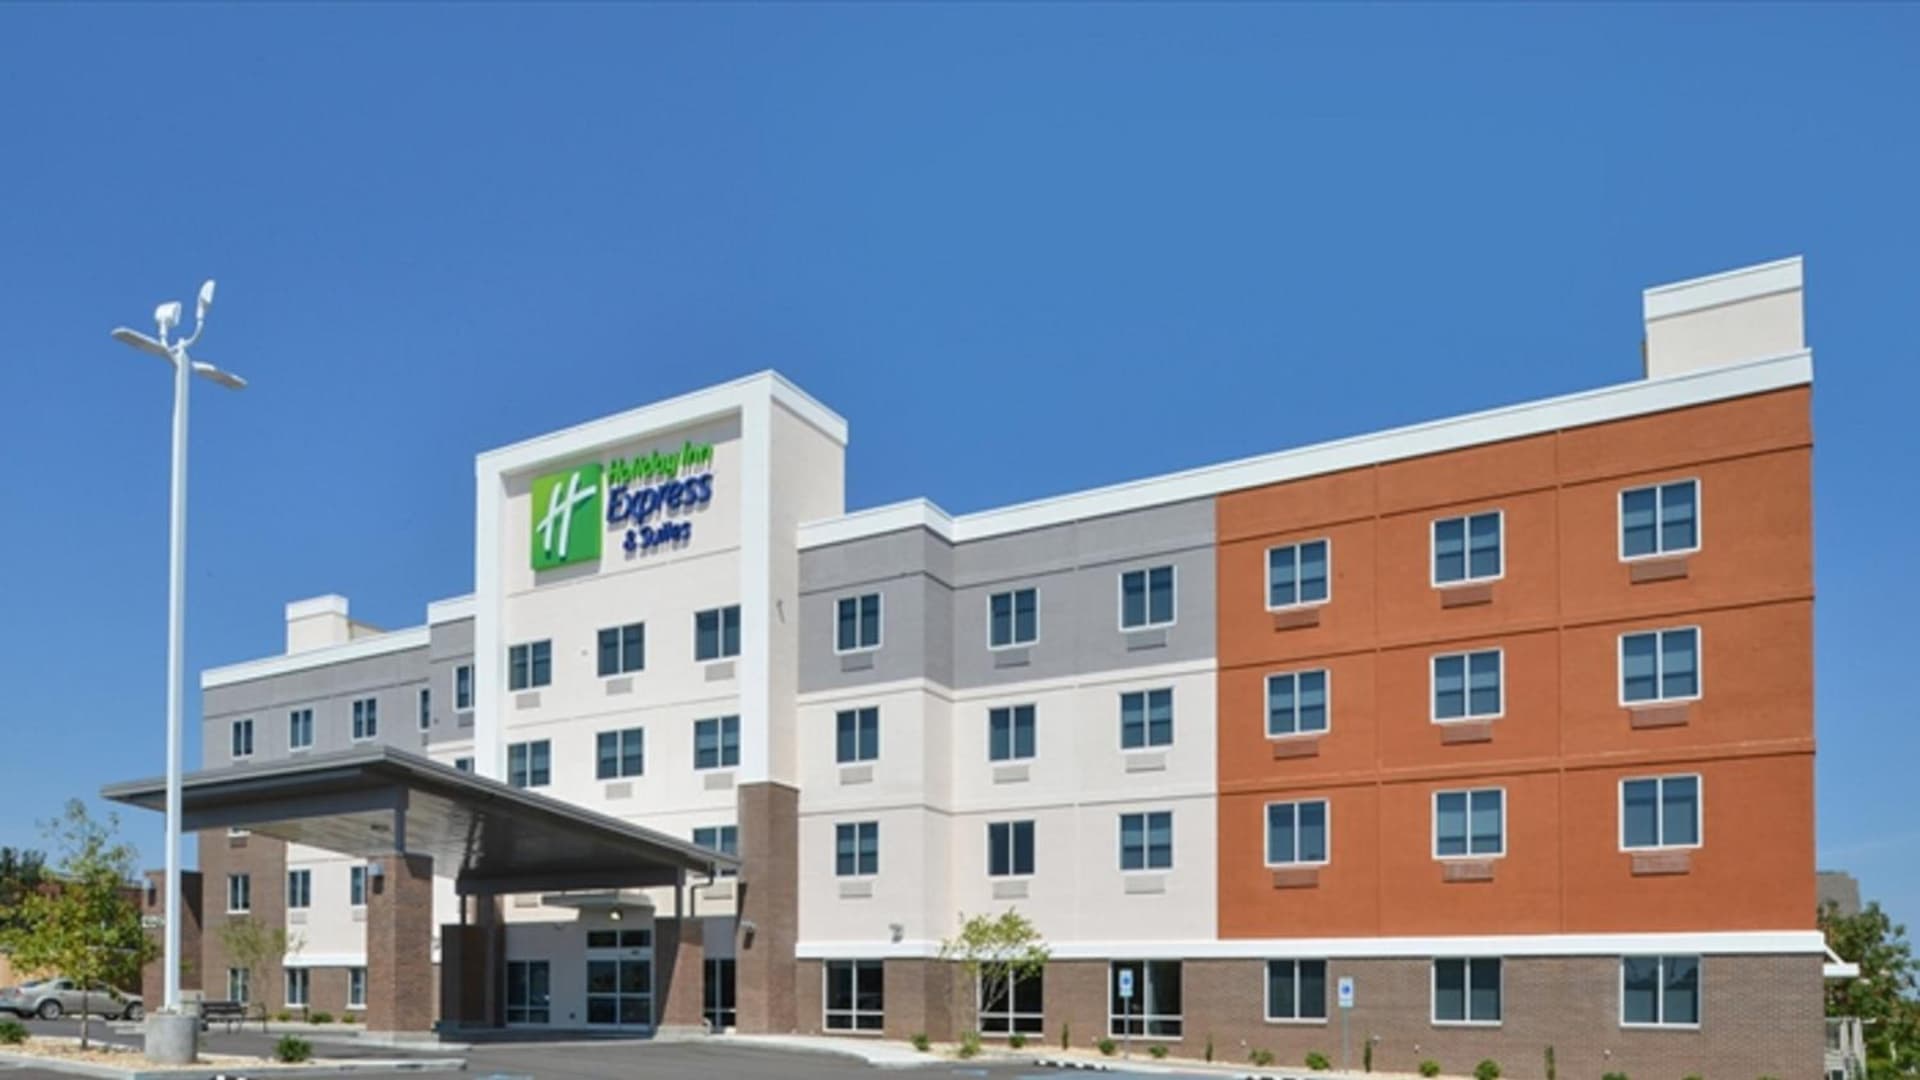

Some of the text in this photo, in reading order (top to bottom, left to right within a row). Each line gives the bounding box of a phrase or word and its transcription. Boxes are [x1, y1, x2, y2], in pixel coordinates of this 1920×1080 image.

[609, 441, 714, 483] Holiday Inn
[536, 471, 597, 557] H
[607, 473, 713, 525] Express
[623, 521, 692, 552] & Suites
